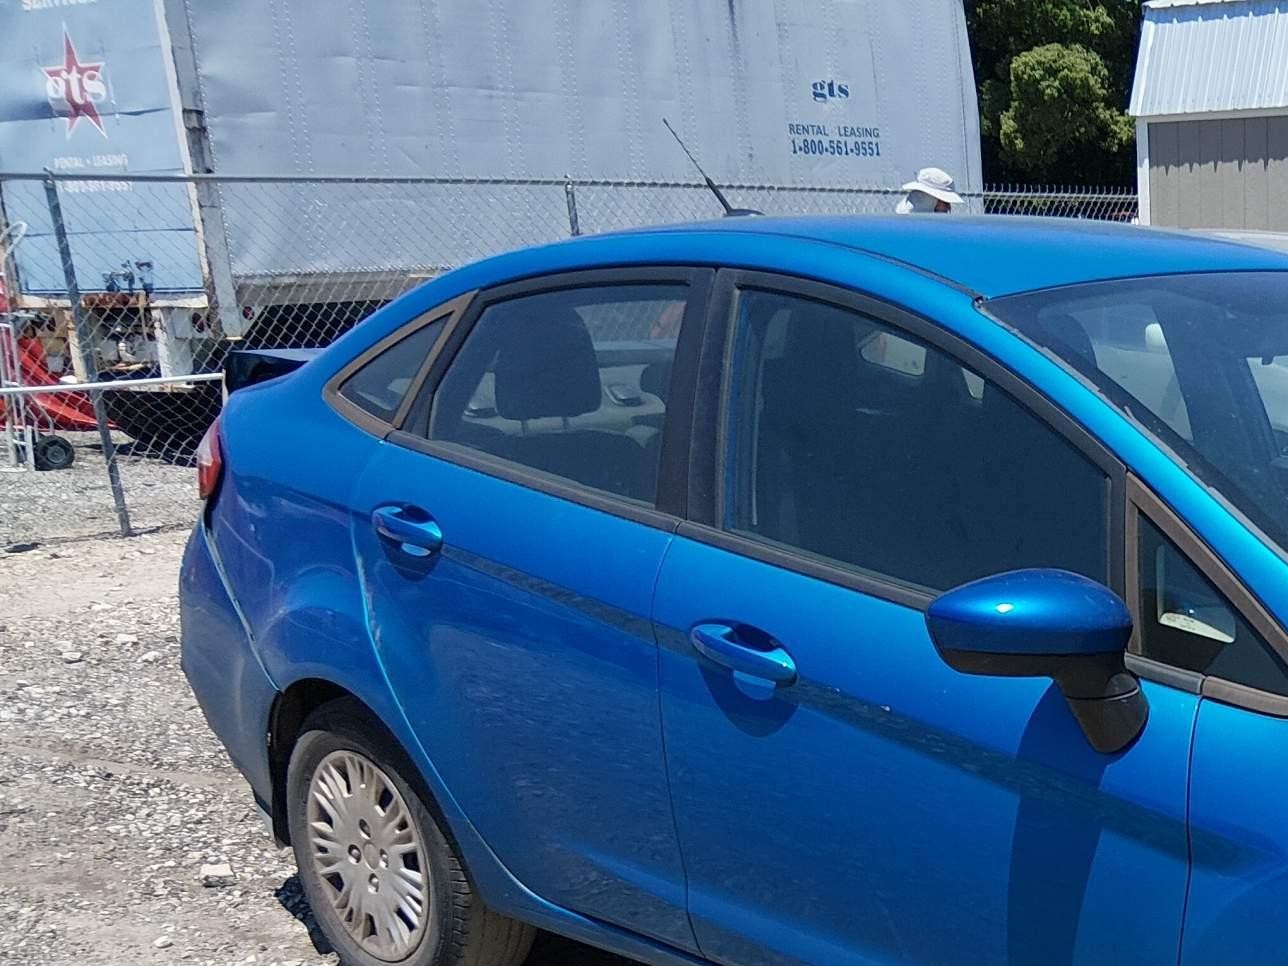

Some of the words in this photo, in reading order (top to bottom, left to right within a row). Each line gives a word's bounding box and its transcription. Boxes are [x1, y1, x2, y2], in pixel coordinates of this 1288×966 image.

[812, 80, 849, 102] gts
[789, 124, 829, 136] RENTAL
[837, 126, 880, 137] LEASING
